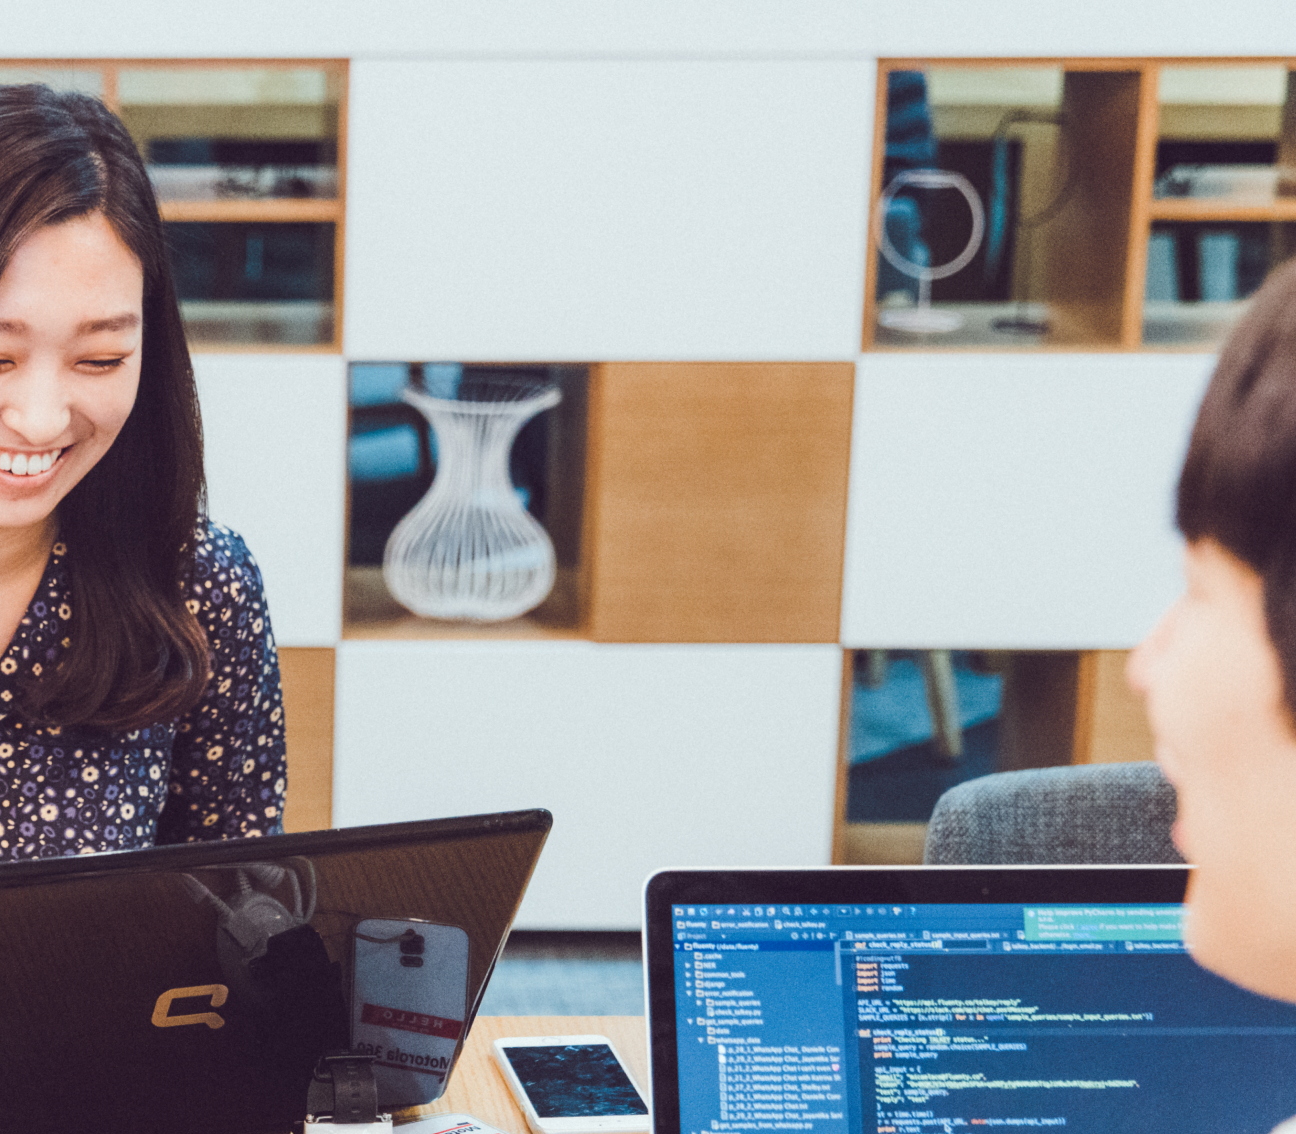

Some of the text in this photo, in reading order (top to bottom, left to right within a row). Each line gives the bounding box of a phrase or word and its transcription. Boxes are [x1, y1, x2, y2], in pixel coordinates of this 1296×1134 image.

[1084, 909, 1115, 917] PyCharm
[955, 1013, 966, 1021] for
[873, 1036, 892, 1044] print
